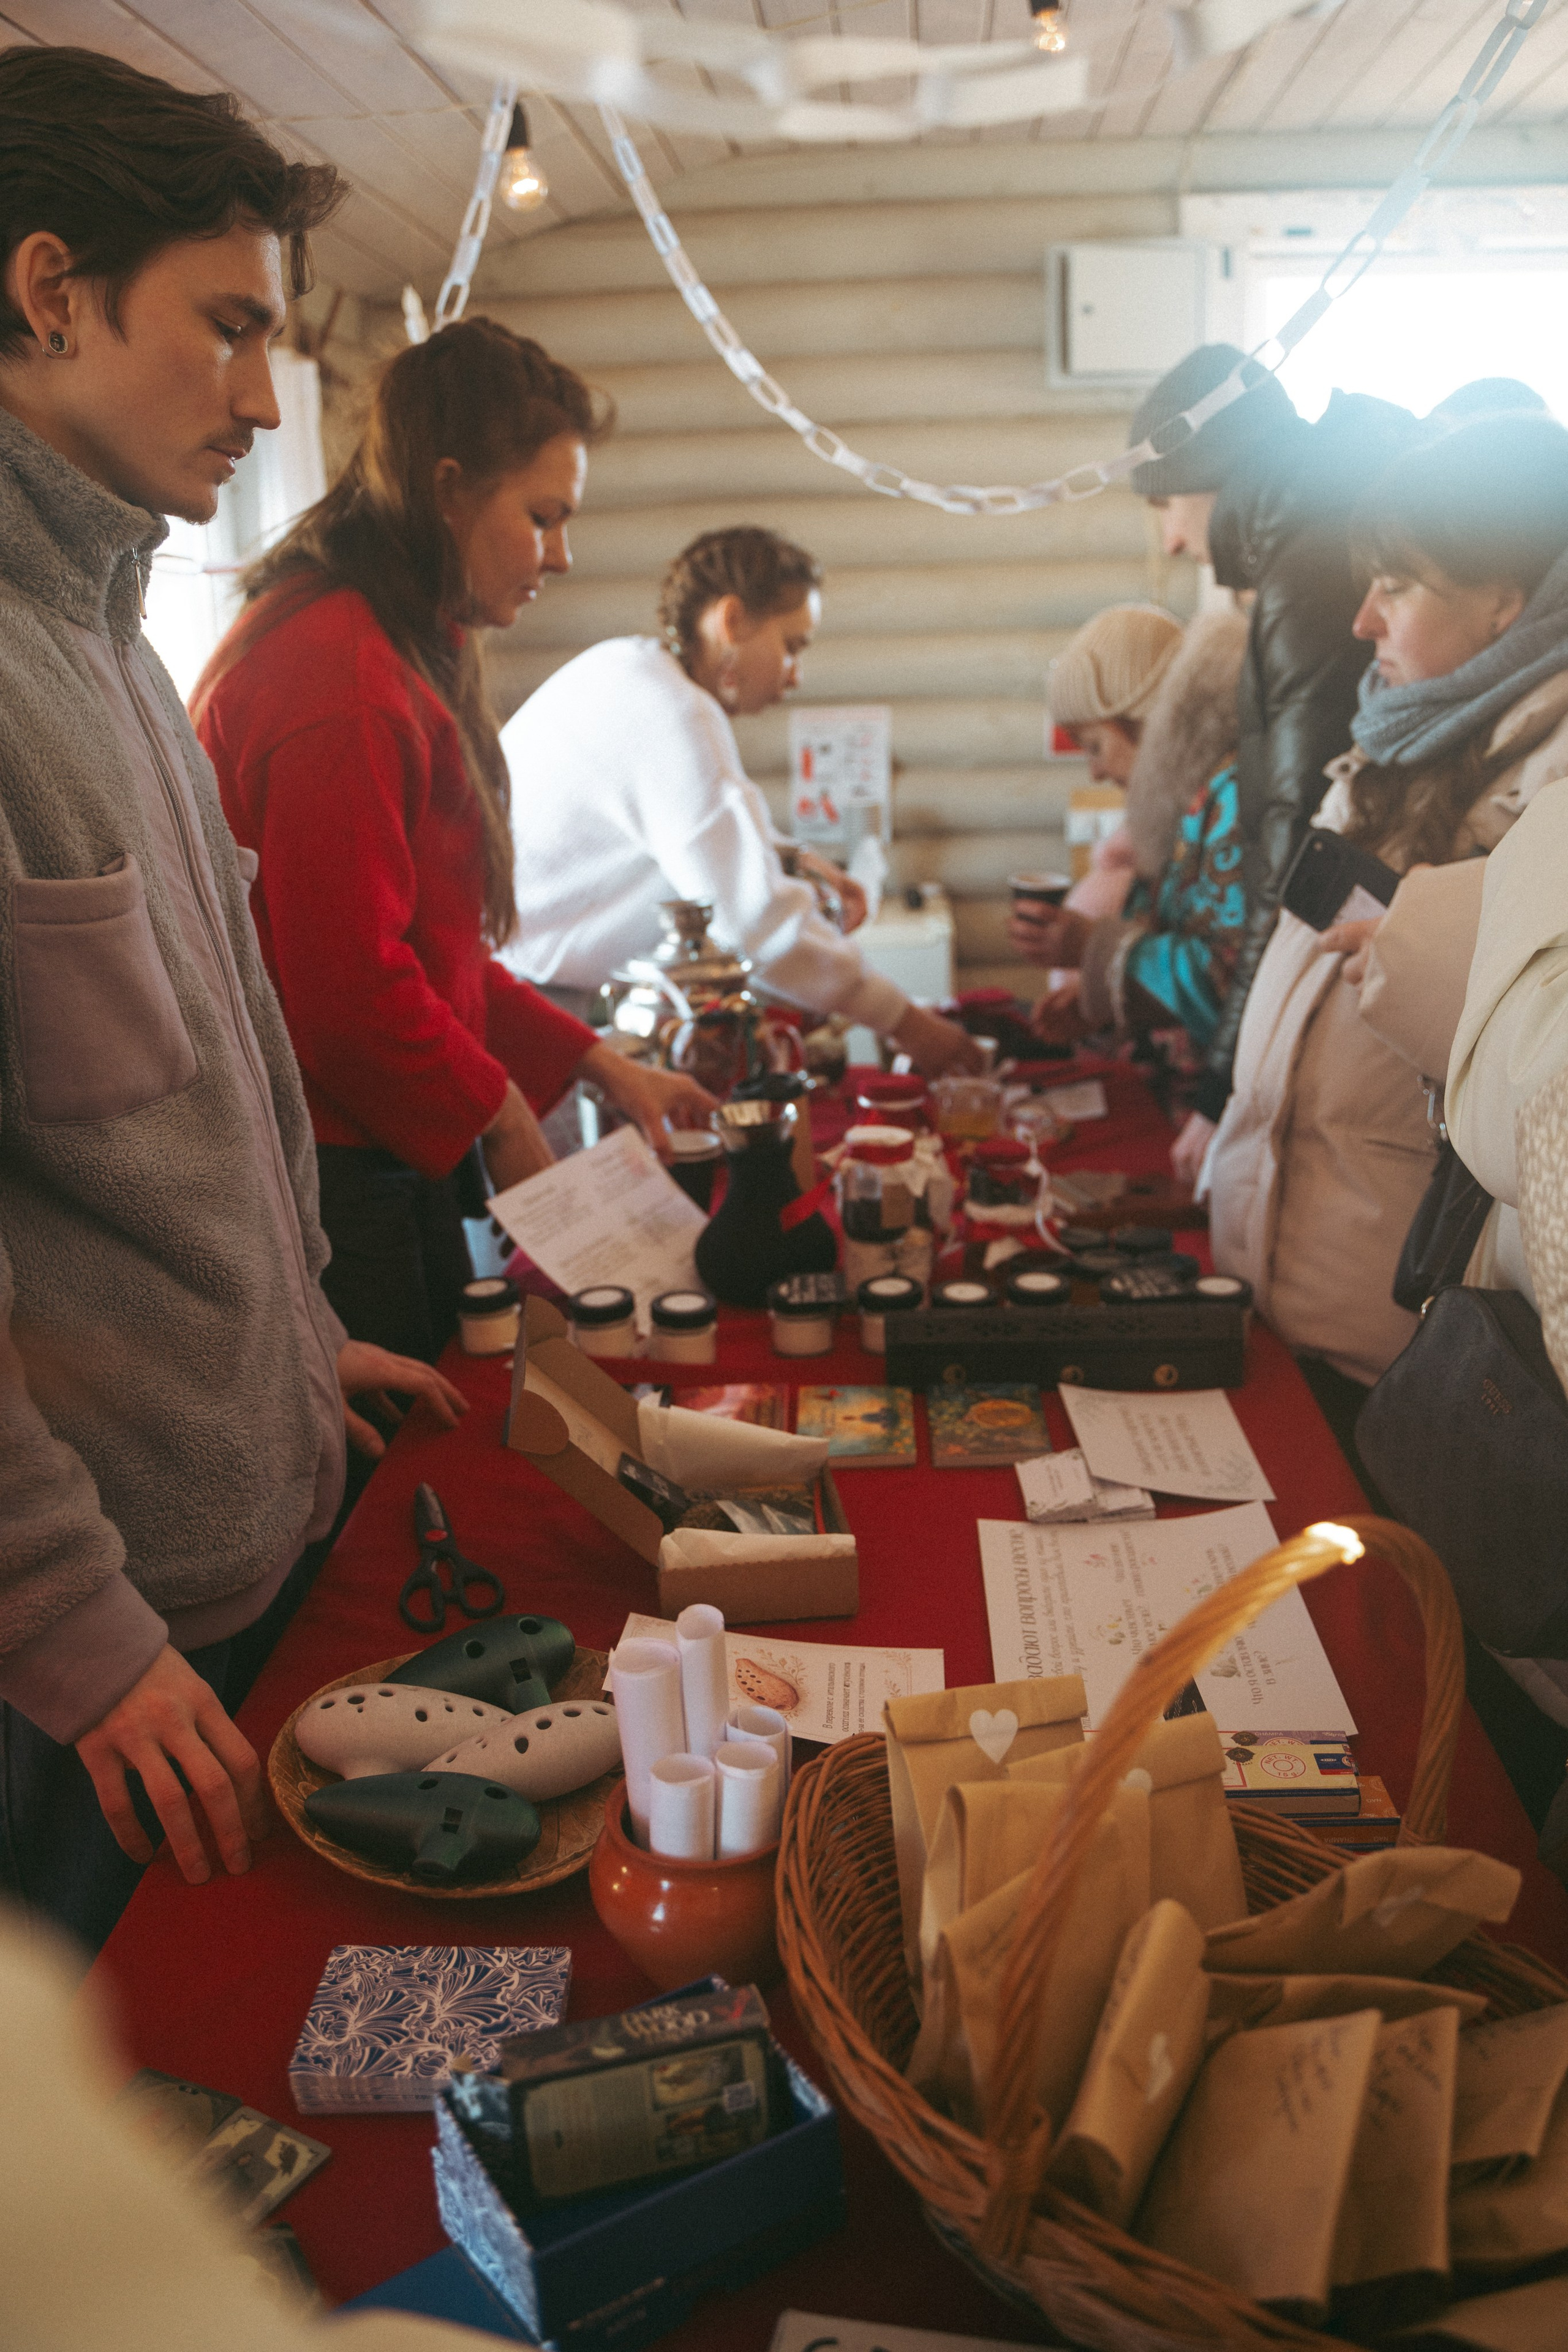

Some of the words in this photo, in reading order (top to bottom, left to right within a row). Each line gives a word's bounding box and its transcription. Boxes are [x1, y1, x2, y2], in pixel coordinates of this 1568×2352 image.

[1483, 1378, 1513, 1414] GUESS
[1008, 1528, 1028, 1565] весне
[1014, 1567, 1038, 1625] вопросы
[1234, 1635, 1253, 1678] оставляю
[1250, 1687, 1264, 1705] Что
[841, 1711, 850, 1732] ocarina
[1264, 1755, 1281, 1765] NET.
[1284, 1755, 1298, 1765] WT.
